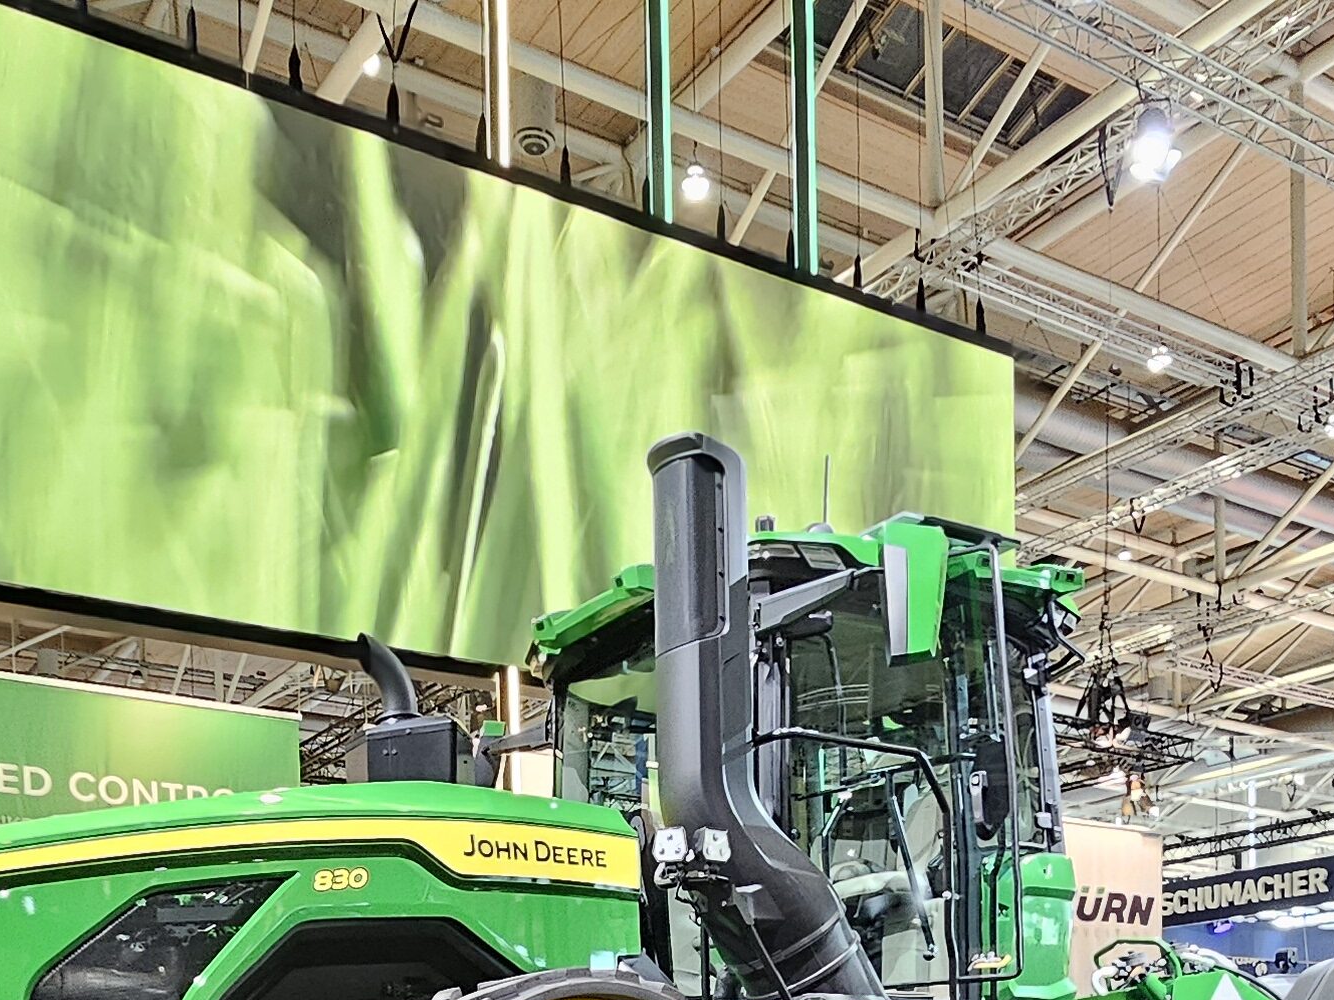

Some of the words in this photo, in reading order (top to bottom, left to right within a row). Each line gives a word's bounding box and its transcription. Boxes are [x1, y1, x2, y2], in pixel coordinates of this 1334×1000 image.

[463, 834, 529, 862] JOHN
[534, 840, 607, 868] DEERE
[312, 866, 369, 892] 830
